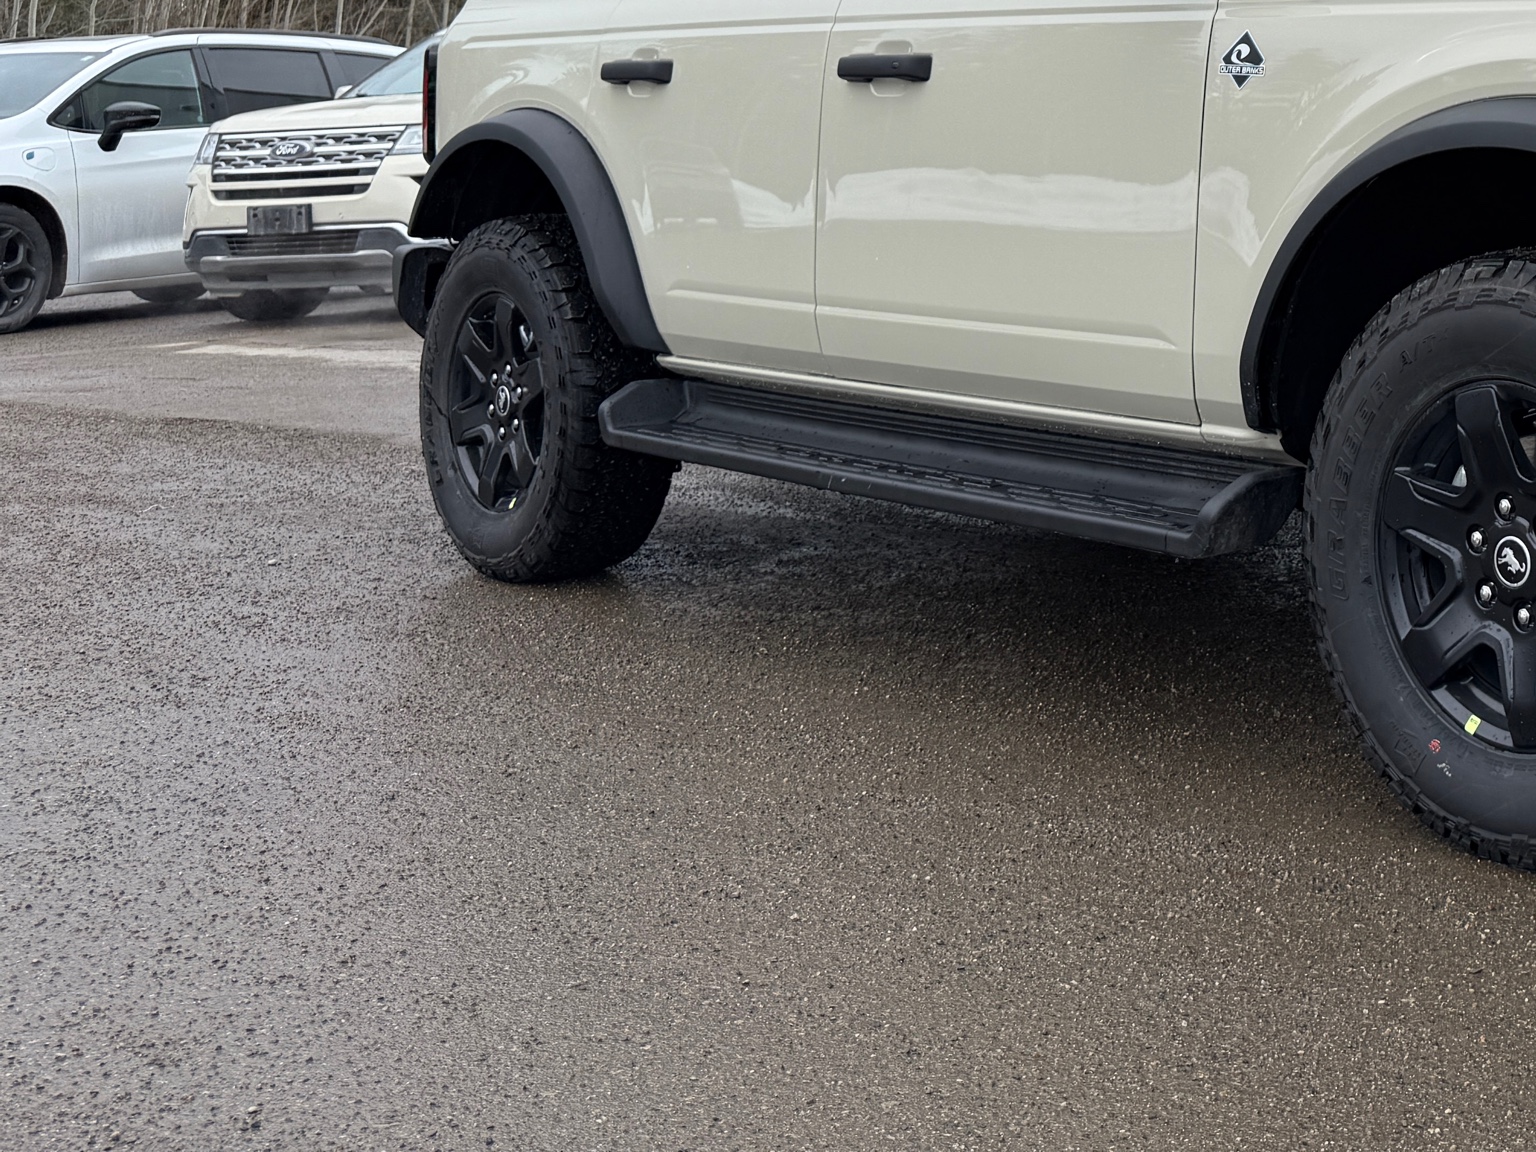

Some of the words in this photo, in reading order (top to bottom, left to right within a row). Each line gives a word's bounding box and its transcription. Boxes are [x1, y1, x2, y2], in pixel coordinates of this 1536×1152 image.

[1220, 65, 1241, 74] OUTER
[1241, 66, 1264, 75] BANKS
[1328, 370, 1393, 601] GRABBER
